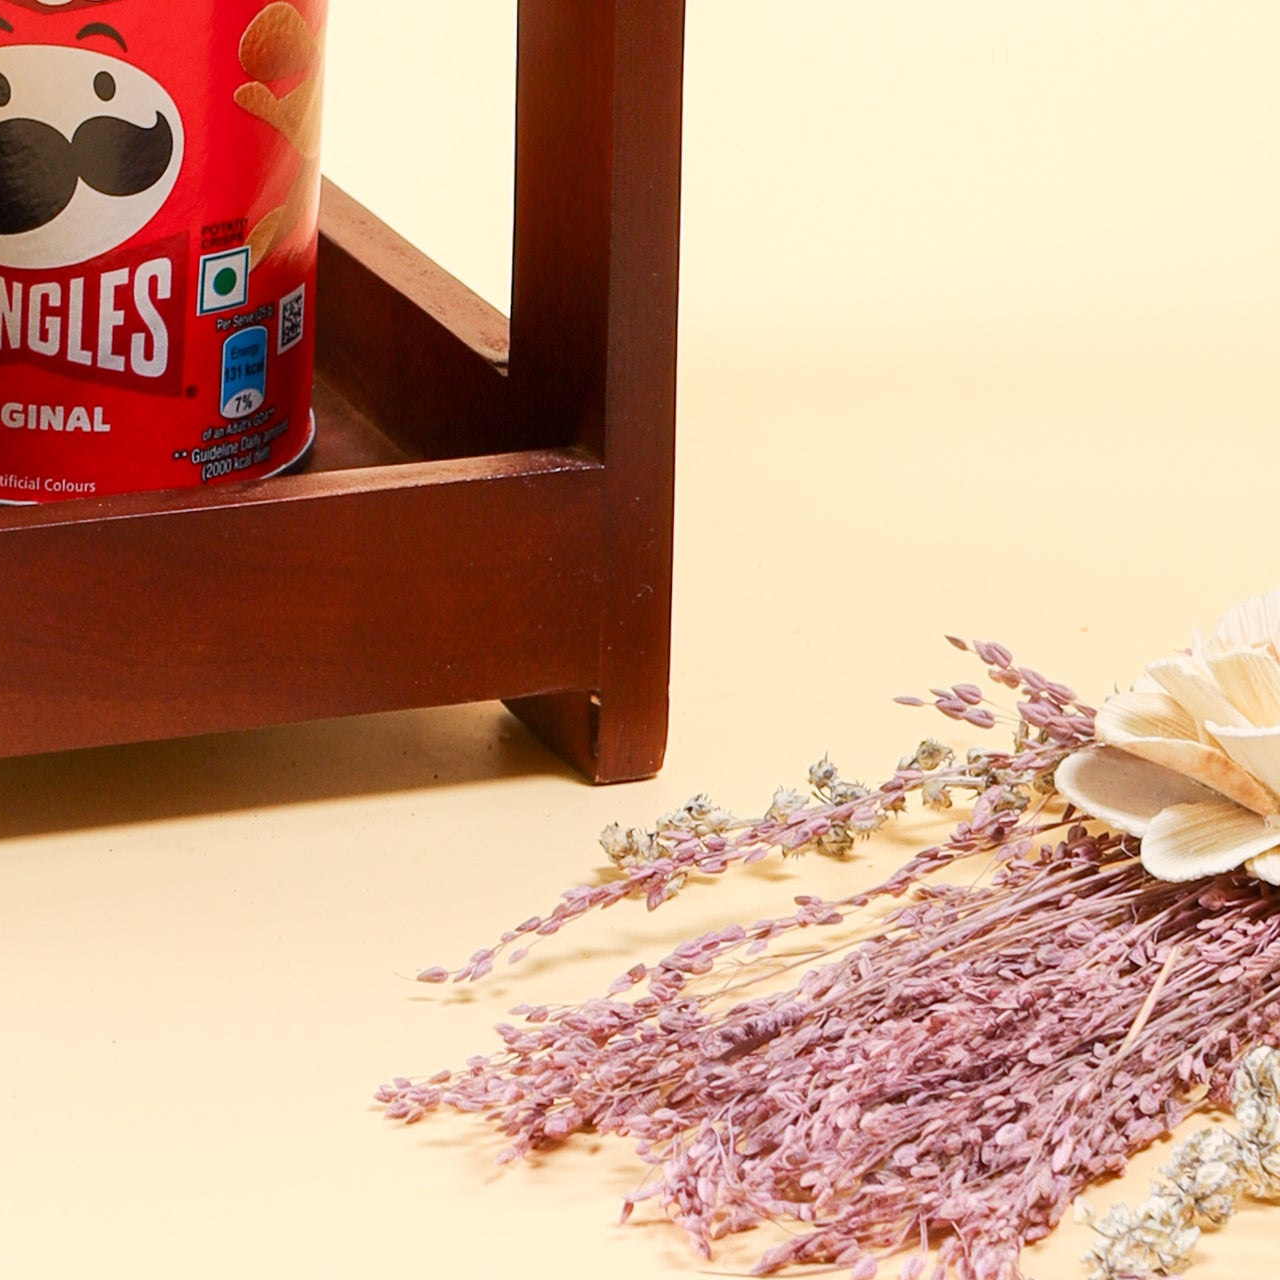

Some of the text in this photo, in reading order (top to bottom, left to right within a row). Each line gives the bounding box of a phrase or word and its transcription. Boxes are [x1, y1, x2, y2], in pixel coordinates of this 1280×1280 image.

[234, 392, 253, 413] 7%
[191, 442, 239, 464] Guideline
[44, 478, 96, 493] Colours
